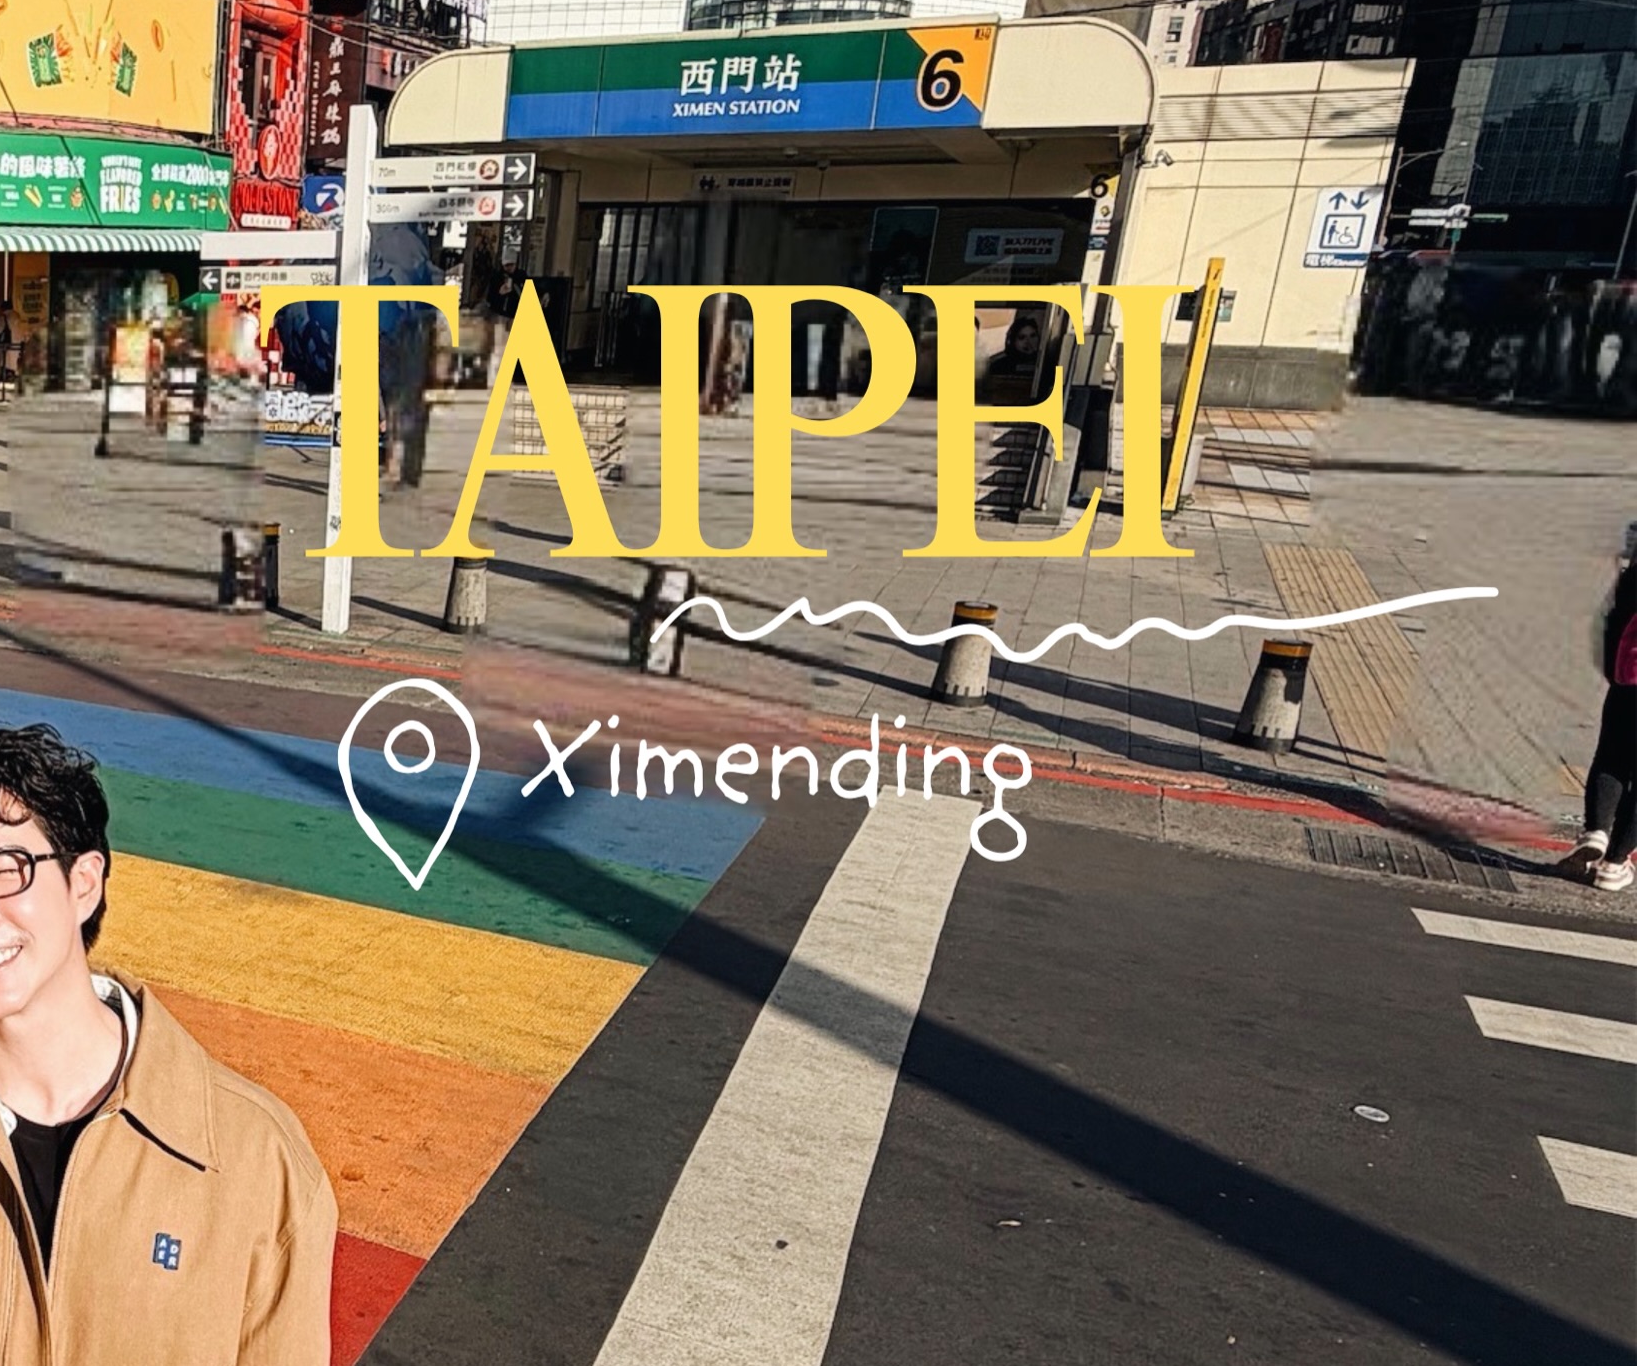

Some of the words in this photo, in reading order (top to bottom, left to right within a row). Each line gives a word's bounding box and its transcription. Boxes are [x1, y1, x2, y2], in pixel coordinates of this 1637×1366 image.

[679, 52, 804, 97] 西門站
[918, 48, 965, 112] 6
[672, 102, 726, 118] XIMEN
[729, 98, 800, 116] STATION
[100, 184, 143, 214] FRIES
